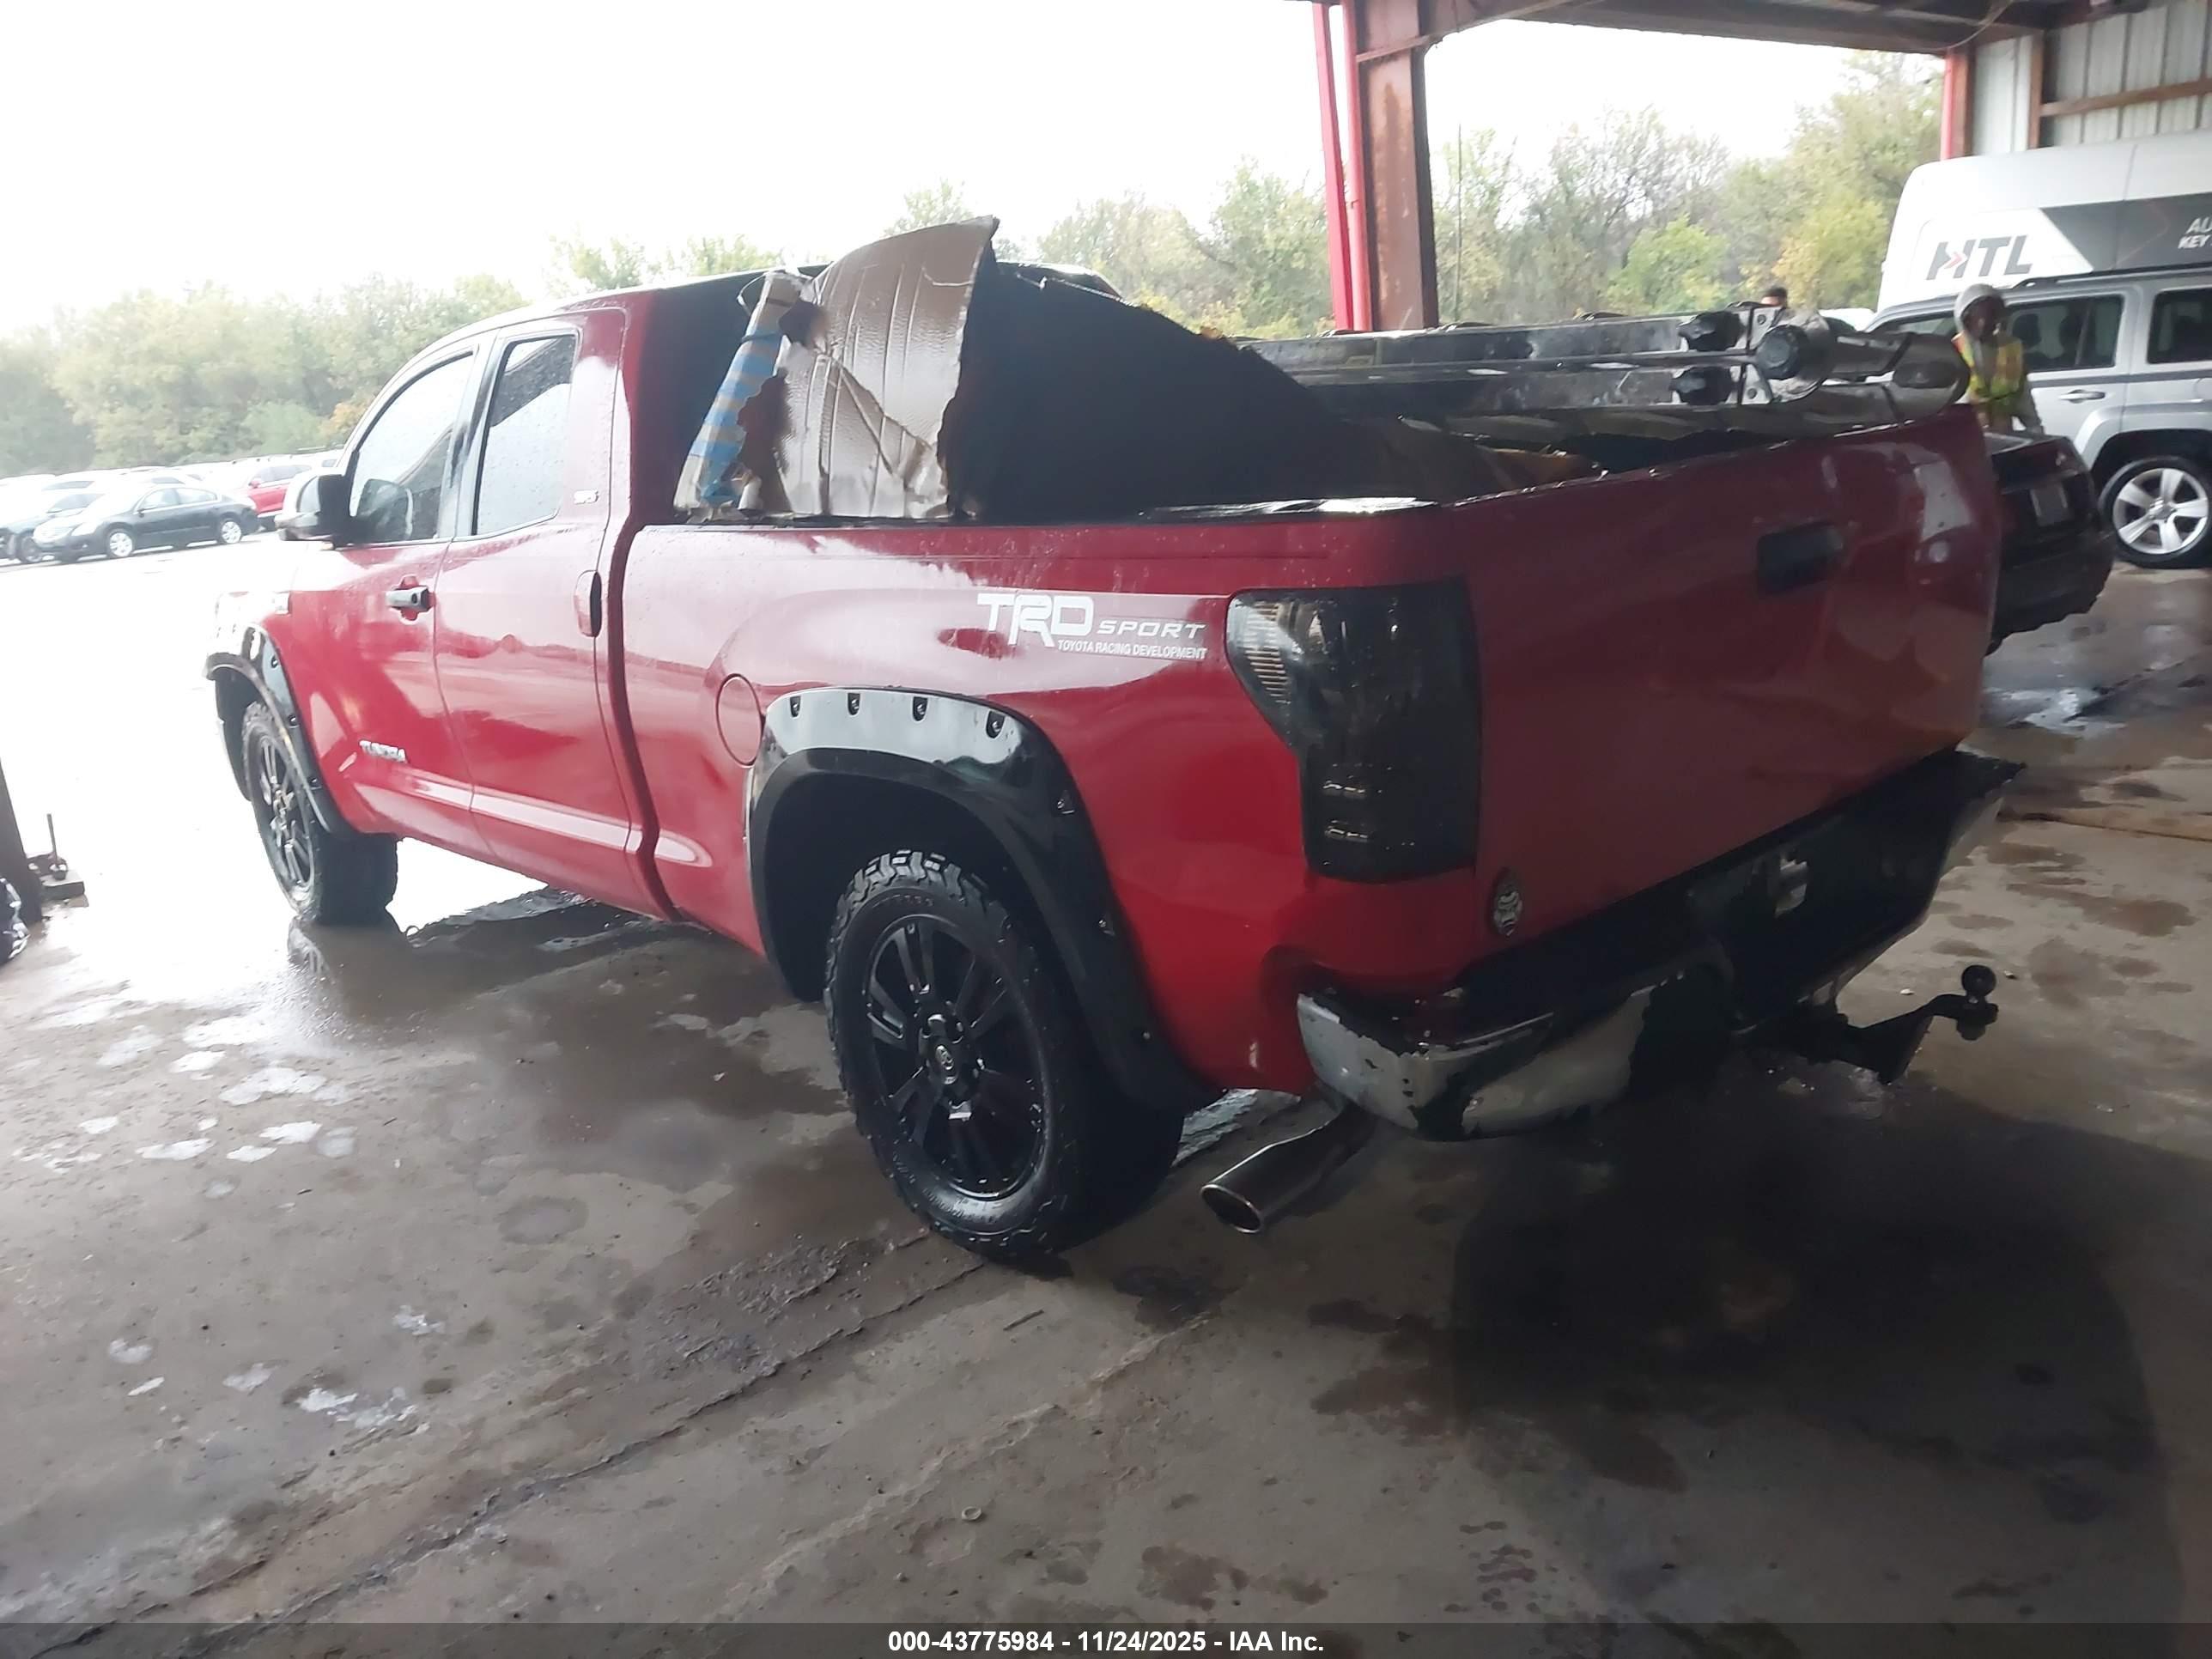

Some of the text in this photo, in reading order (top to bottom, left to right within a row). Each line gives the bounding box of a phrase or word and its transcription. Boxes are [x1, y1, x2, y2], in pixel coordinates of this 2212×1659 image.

[1926, 234, 2033, 281] HTL
[2178, 234, 2211, 249] KEY
[977, 592, 1206, 647] TRD SPORT
[1057, 639, 1208, 660] TOYOTA RACING DEVELOPMENT
